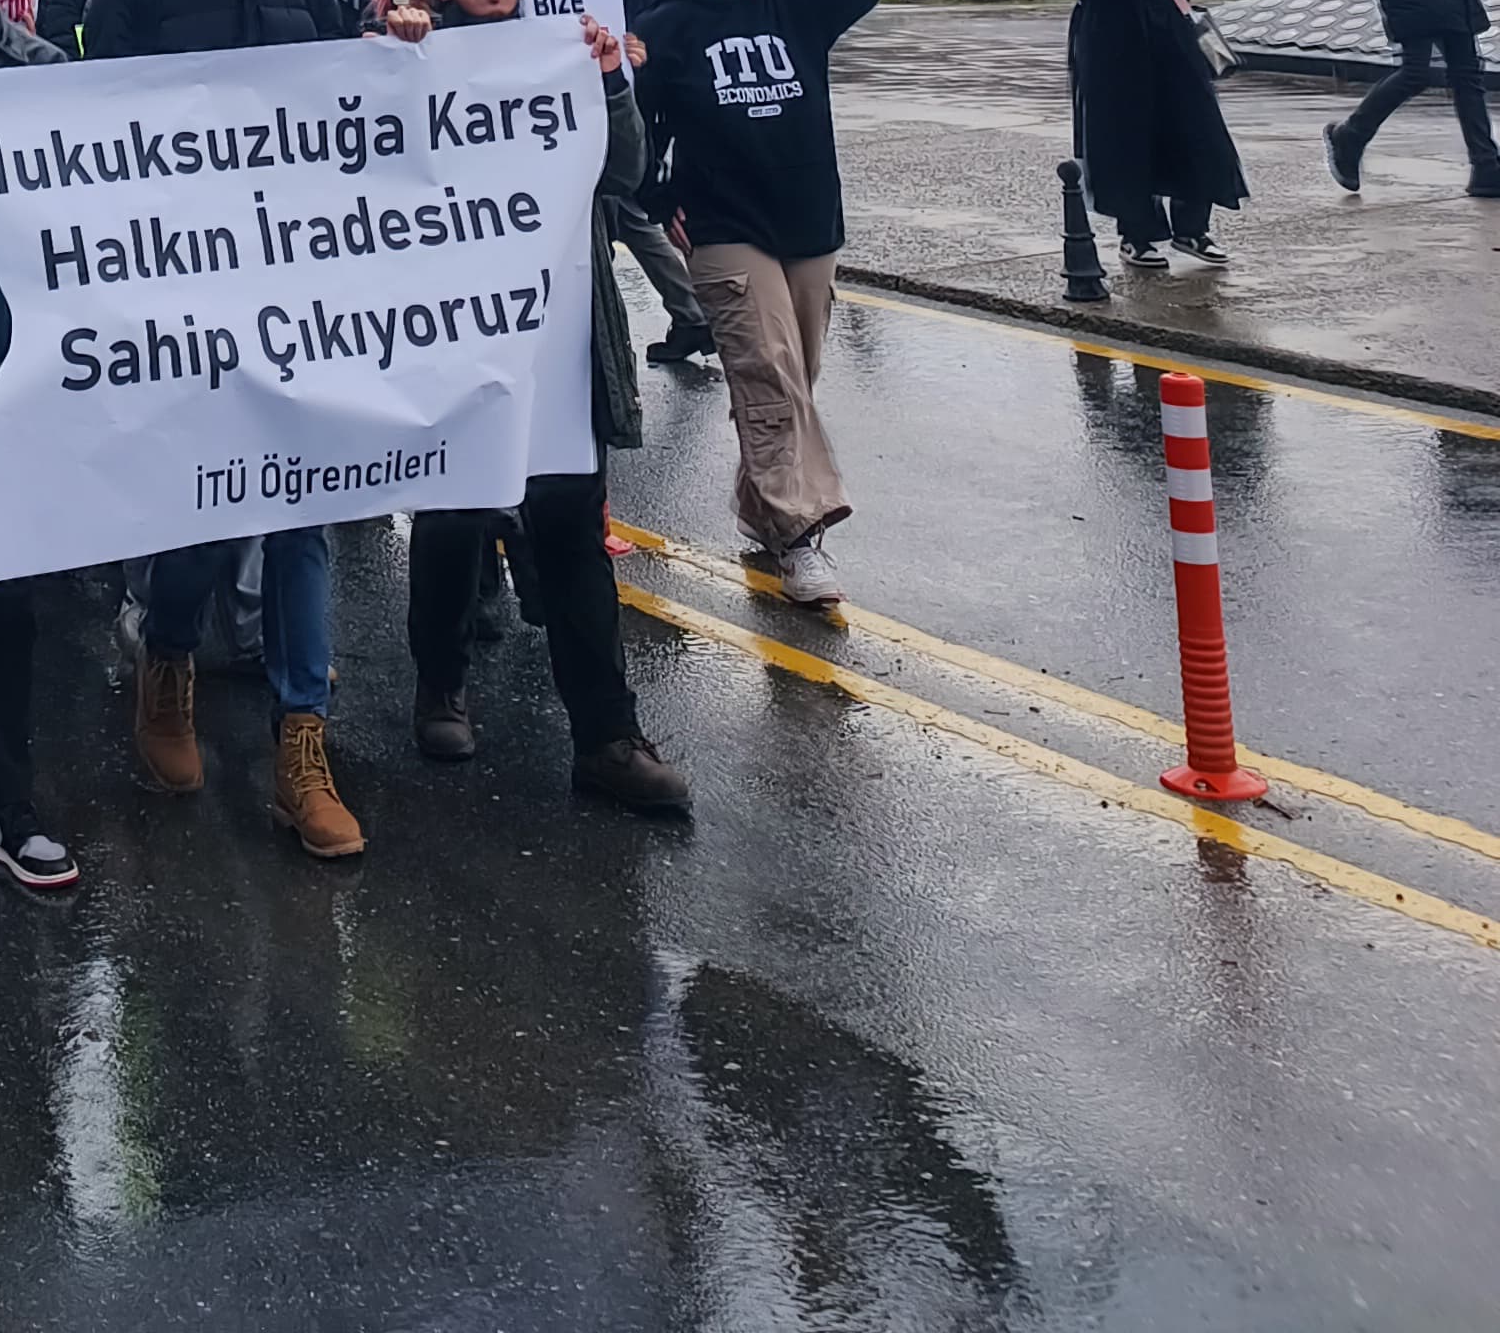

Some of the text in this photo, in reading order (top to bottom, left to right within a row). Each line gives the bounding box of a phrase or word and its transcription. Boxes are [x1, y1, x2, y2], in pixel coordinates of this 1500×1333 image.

[705, 34, 795, 90] ITU
[716, 81, 804, 105] ECONOMICS
[426, 90, 580, 151] Karşı
[39, 191, 543, 291] Halkın İradesine
[60, 268, 552, 391] Sahip Çıkıyoruz!
[195, 441, 448, 510] İTÜ Öğrencileri
